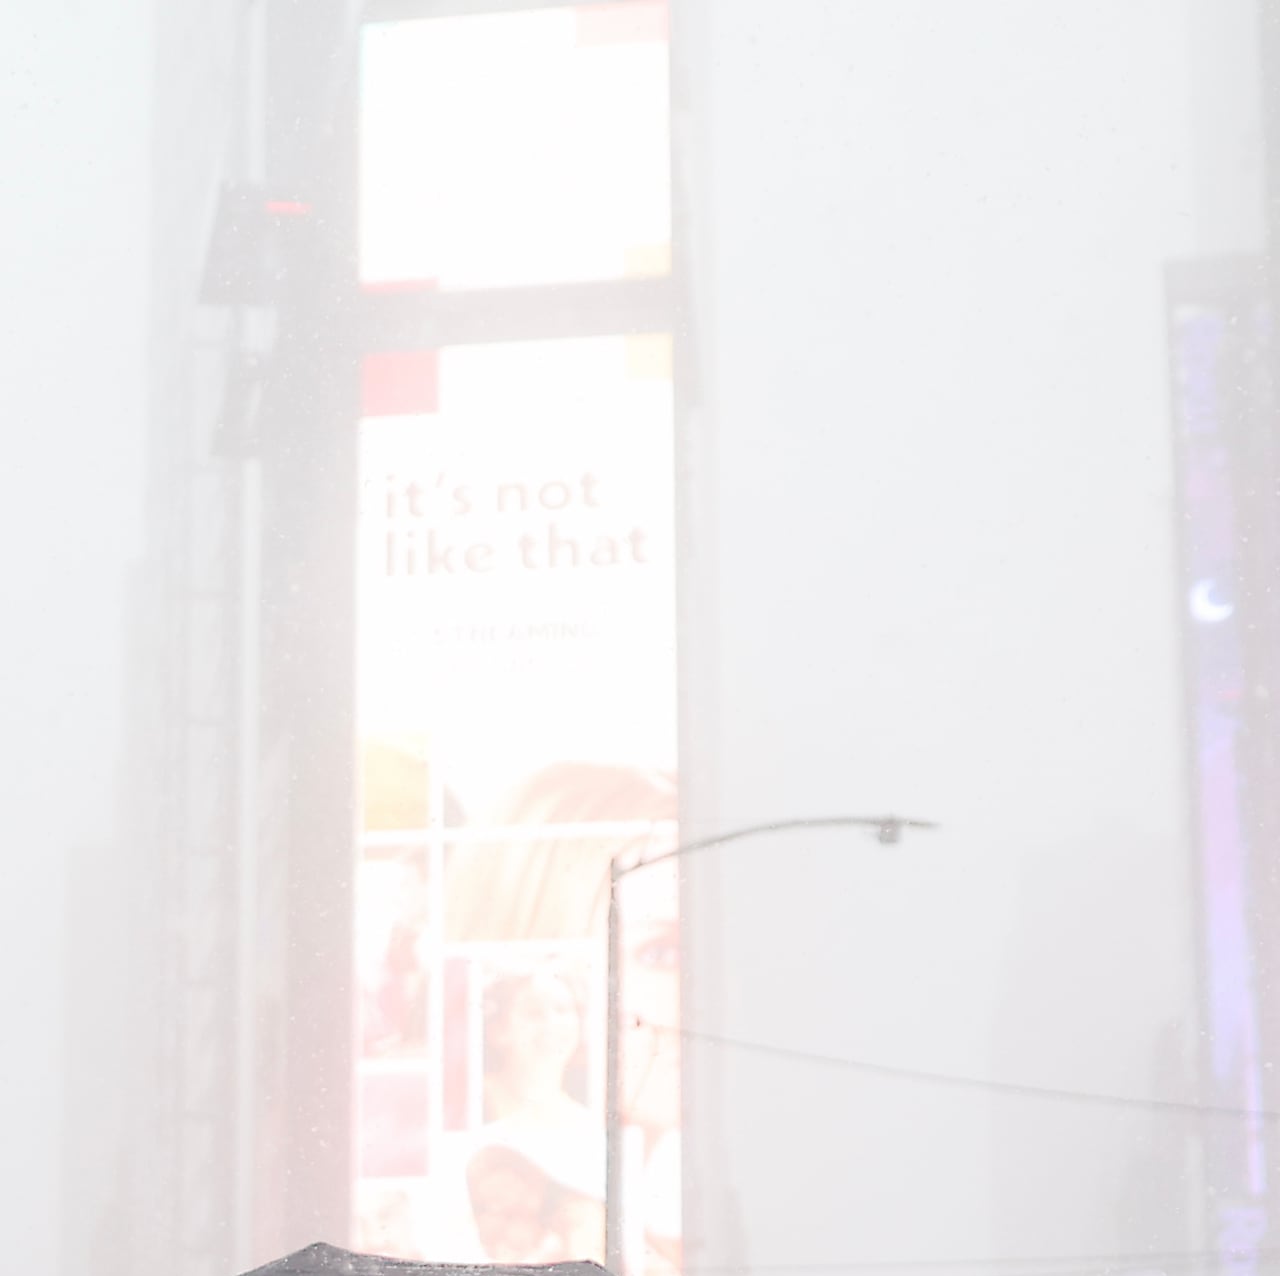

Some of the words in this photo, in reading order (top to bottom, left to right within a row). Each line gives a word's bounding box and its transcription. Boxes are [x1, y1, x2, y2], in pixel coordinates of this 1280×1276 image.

[385, 472, 472, 518] it's
[496, 472, 600, 513] not
[385, 527, 496, 577] like
[518, 522, 649, 570] that
